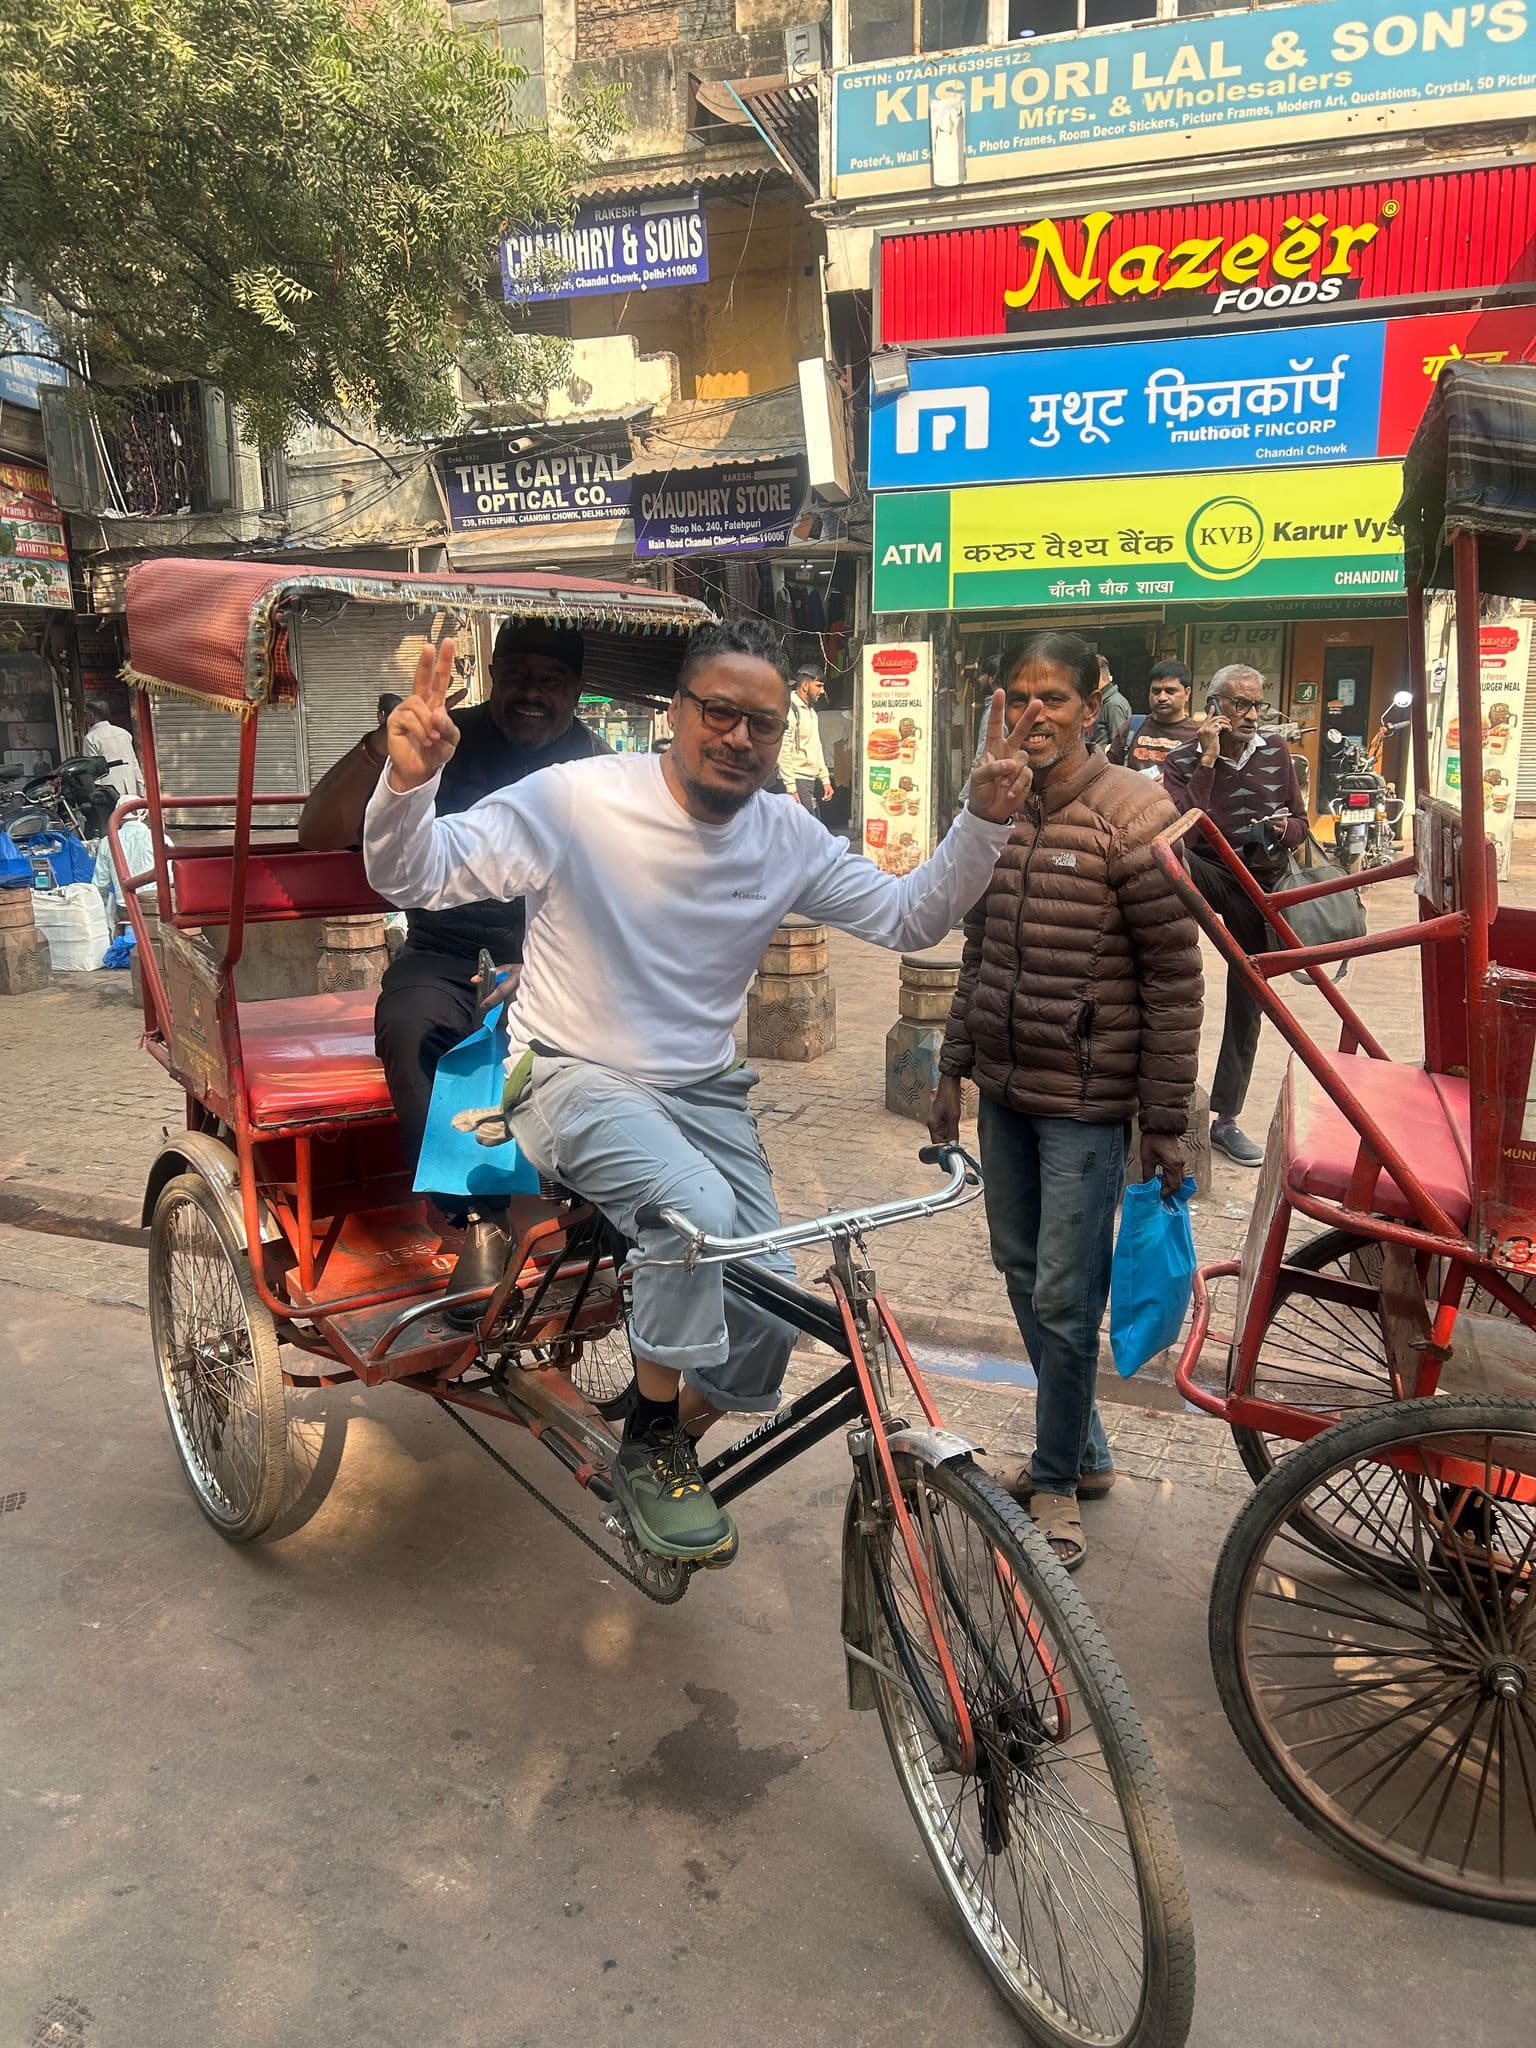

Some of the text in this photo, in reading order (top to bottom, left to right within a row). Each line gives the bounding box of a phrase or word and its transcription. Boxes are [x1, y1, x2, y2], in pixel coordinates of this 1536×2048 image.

[876, 0, 1528, 126] KISHORI LAL & SON'S
[843, 73, 892, 89] GSTIN:
[1019, 70, 1353, 130] Mfrs. & Wholesalers
[850, 154, 895, 170] Poster's,
[896, 149, 919, 163] Wall
[979, 139, 1010, 153] Photo
[1013, 134, 1056, 149] Frames,
[1059, 129, 1090, 142] Room
[1093, 123, 1125, 138] Decor
[1129, 116, 1180, 133] Stickers,
[1182, 111, 1223, 126] Picture
[1227, 105, 1274, 121] Frames,
[1277, 98, 1321, 114] Modern
[1324, 95, 1348, 108] Art,
[1351, 87, 1421, 104] Quotations,
[1425, 79, 1473, 97] Crystal,
[1477, 76, 1494, 90] 5D
[622, 223, 639, 266] &
[645, 213, 703, 264] SONS
[575, 274, 608, 289] Chandni
[610, 271, 642, 287] Chowk,
[643, 264, 698, 281] Delhi-110006
[1213, 277, 1346, 315] FOODS
[1028, 389, 1128, 448] मुथूट
[1170, 419, 1336, 443] muthoot FINCORP
[1255, 443, 1347, 459] Chandni Chowk
[455, 453, 628, 494] THE CAPITAL
[476, 485, 612, 514] OPTICAL CO.
[641, 483, 791, 521] CHAUDHRY STORE
[518, 512, 551, 523] CHANDNI
[552, 510, 581, 522] CHOWK,
[581, 507, 631, 518] DELHI-110006
[670, 518, 761, 535] Shop No. 240, Fatehpuri
[648, 539, 665, 550] Main
[666, 538, 684, 548] Road
[684, 536, 712, 547] Chandni
[1200, 525, 1253, 546] KVB
[1273, 520, 1348, 542] Karur
[881, 542, 943, 566] ATM
[963, 528, 1174, 563] करुर वैश्य बैंक
[1048, 578, 1175, 598] चाँदनी चौक शाखा
[1334, 569, 1399, 585] CHANDINI
[1480, 682, 1521, 691] URGER MEAL
